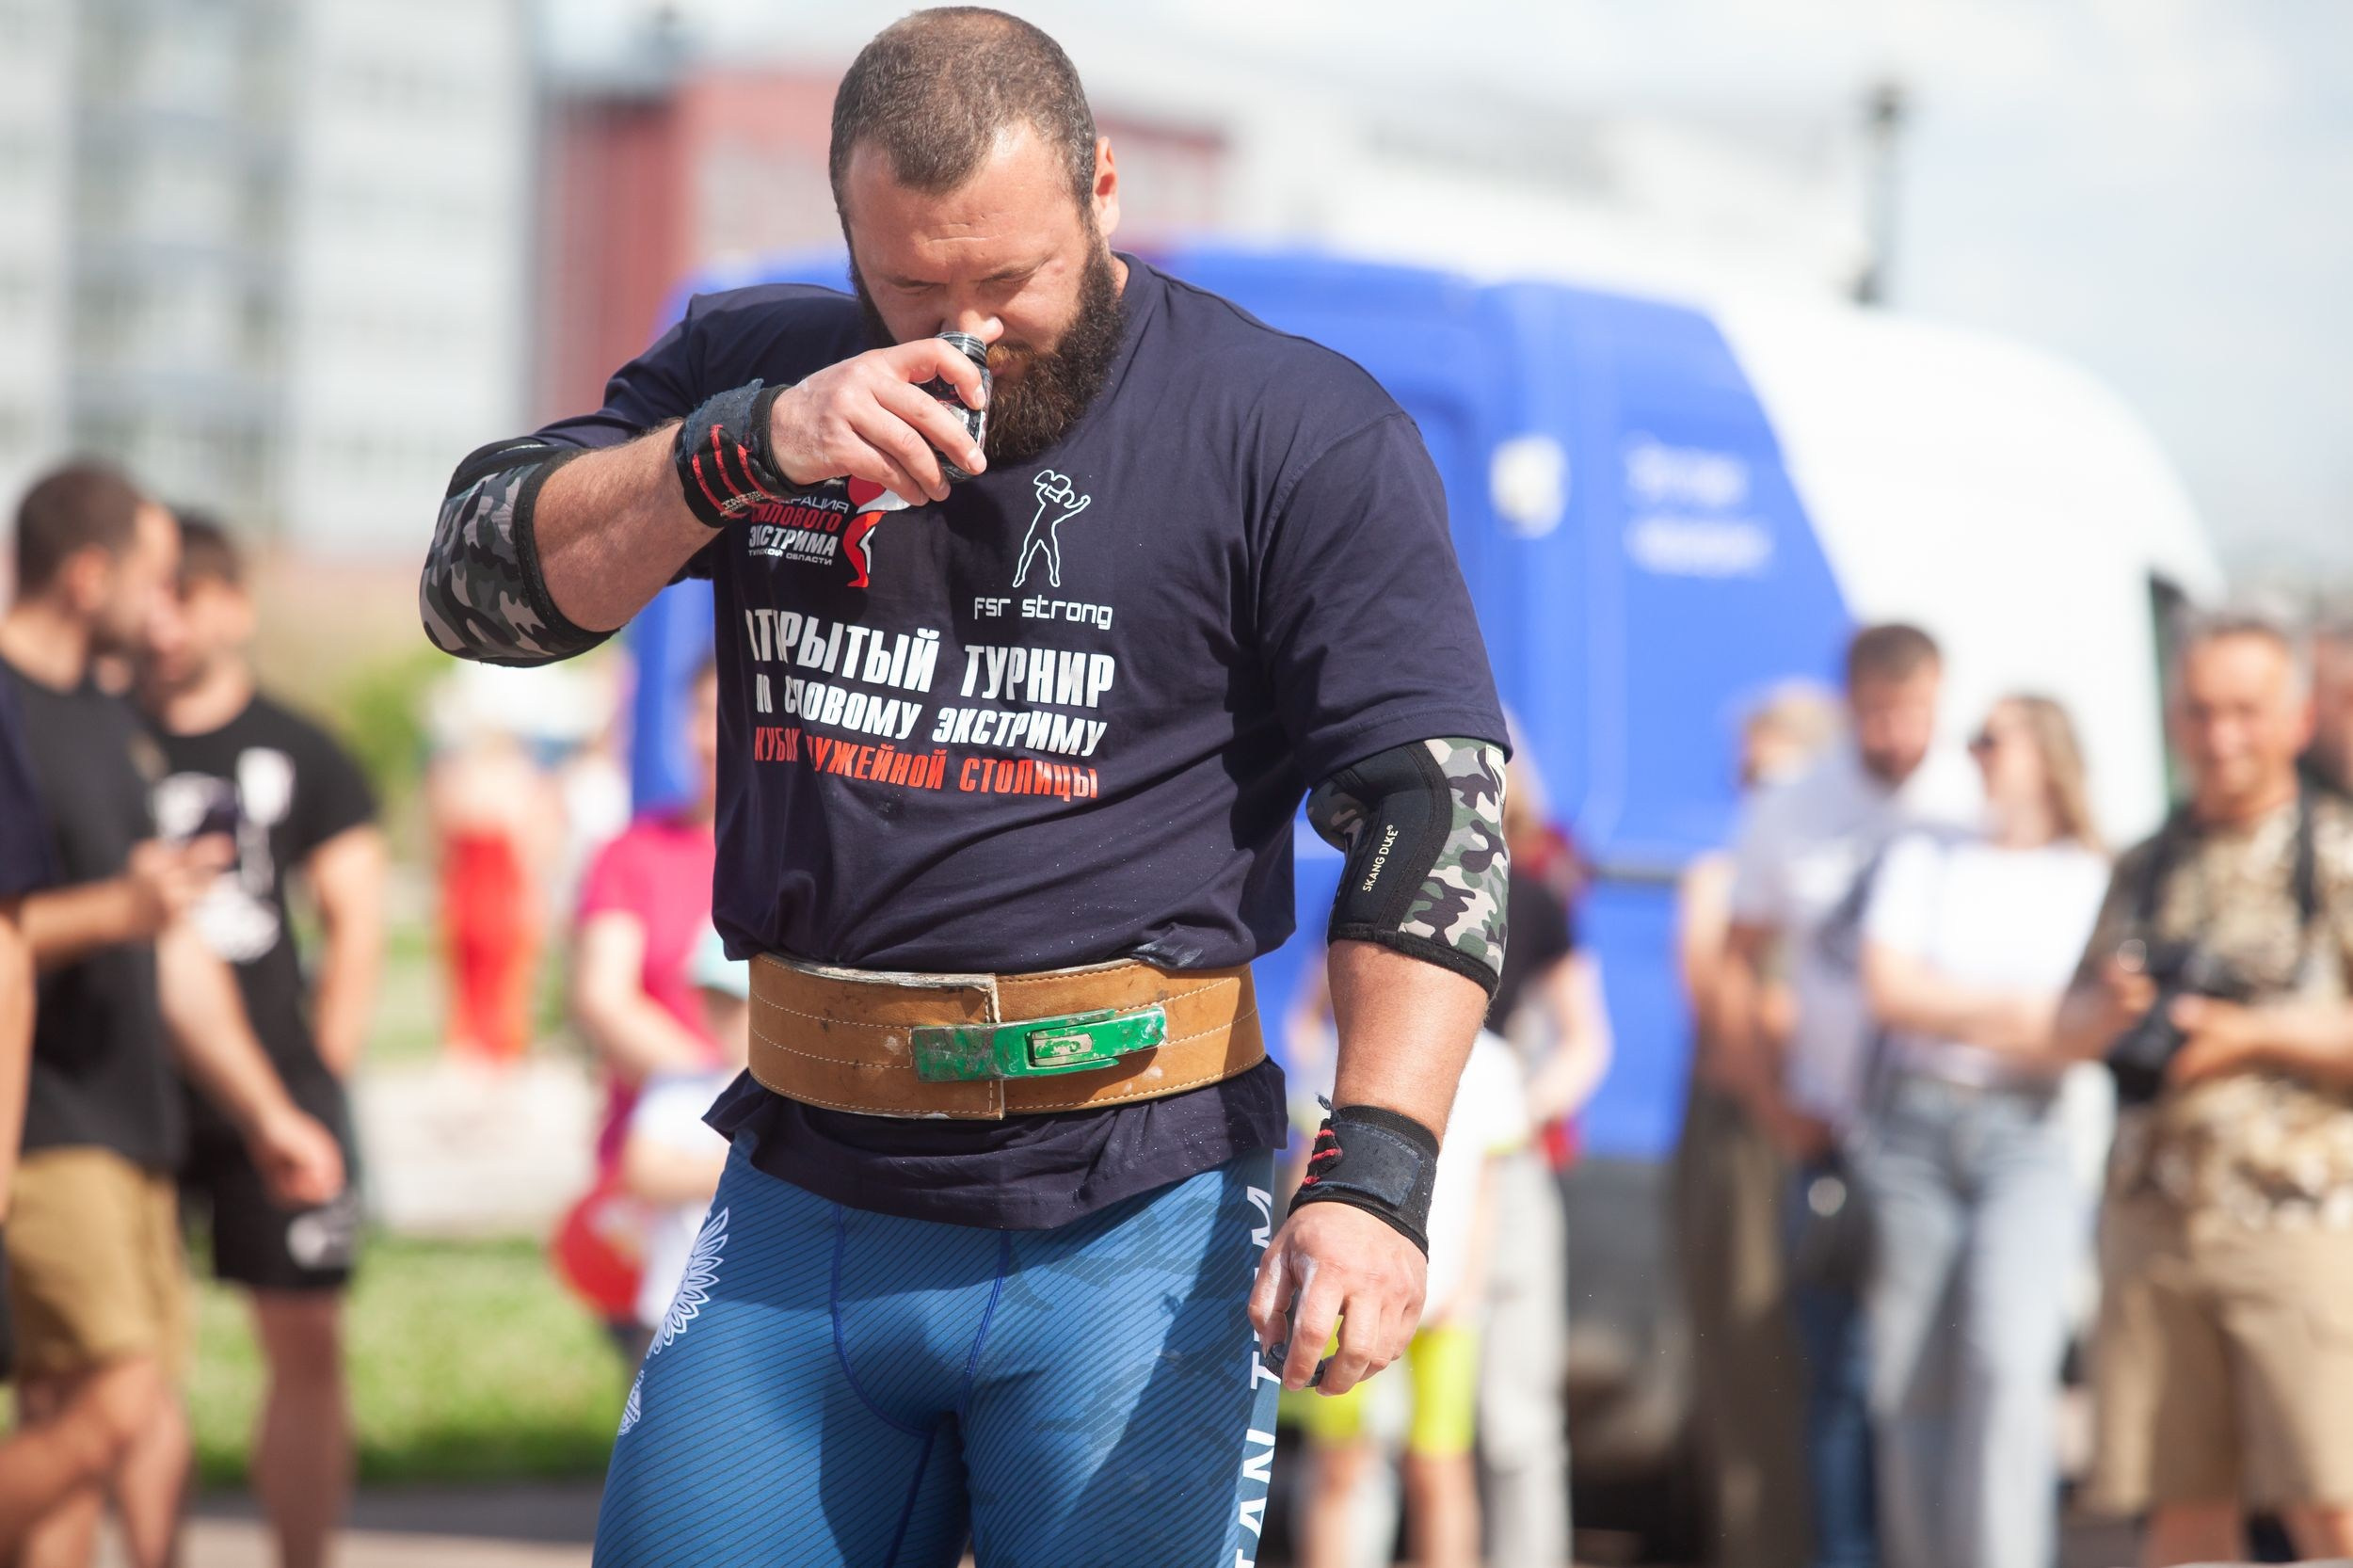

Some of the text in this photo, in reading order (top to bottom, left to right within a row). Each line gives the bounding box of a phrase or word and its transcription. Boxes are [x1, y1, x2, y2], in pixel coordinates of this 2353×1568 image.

[785, 552, 833, 566] ОБЛАСТИ
[1021, 595, 1113, 631] strong
[745, 609, 1115, 709] ТРЫТЫЙ ТУРНИР
[784, 675, 922, 741] СЛОВОМУ
[931, 707, 1108, 757] ЭКСТРИМУ
[754, 727, 1098, 803] КУБОК УЖЕЙНОЙ СТОЛИЦЫ
[1362, 856, 1385, 892] SKANG
